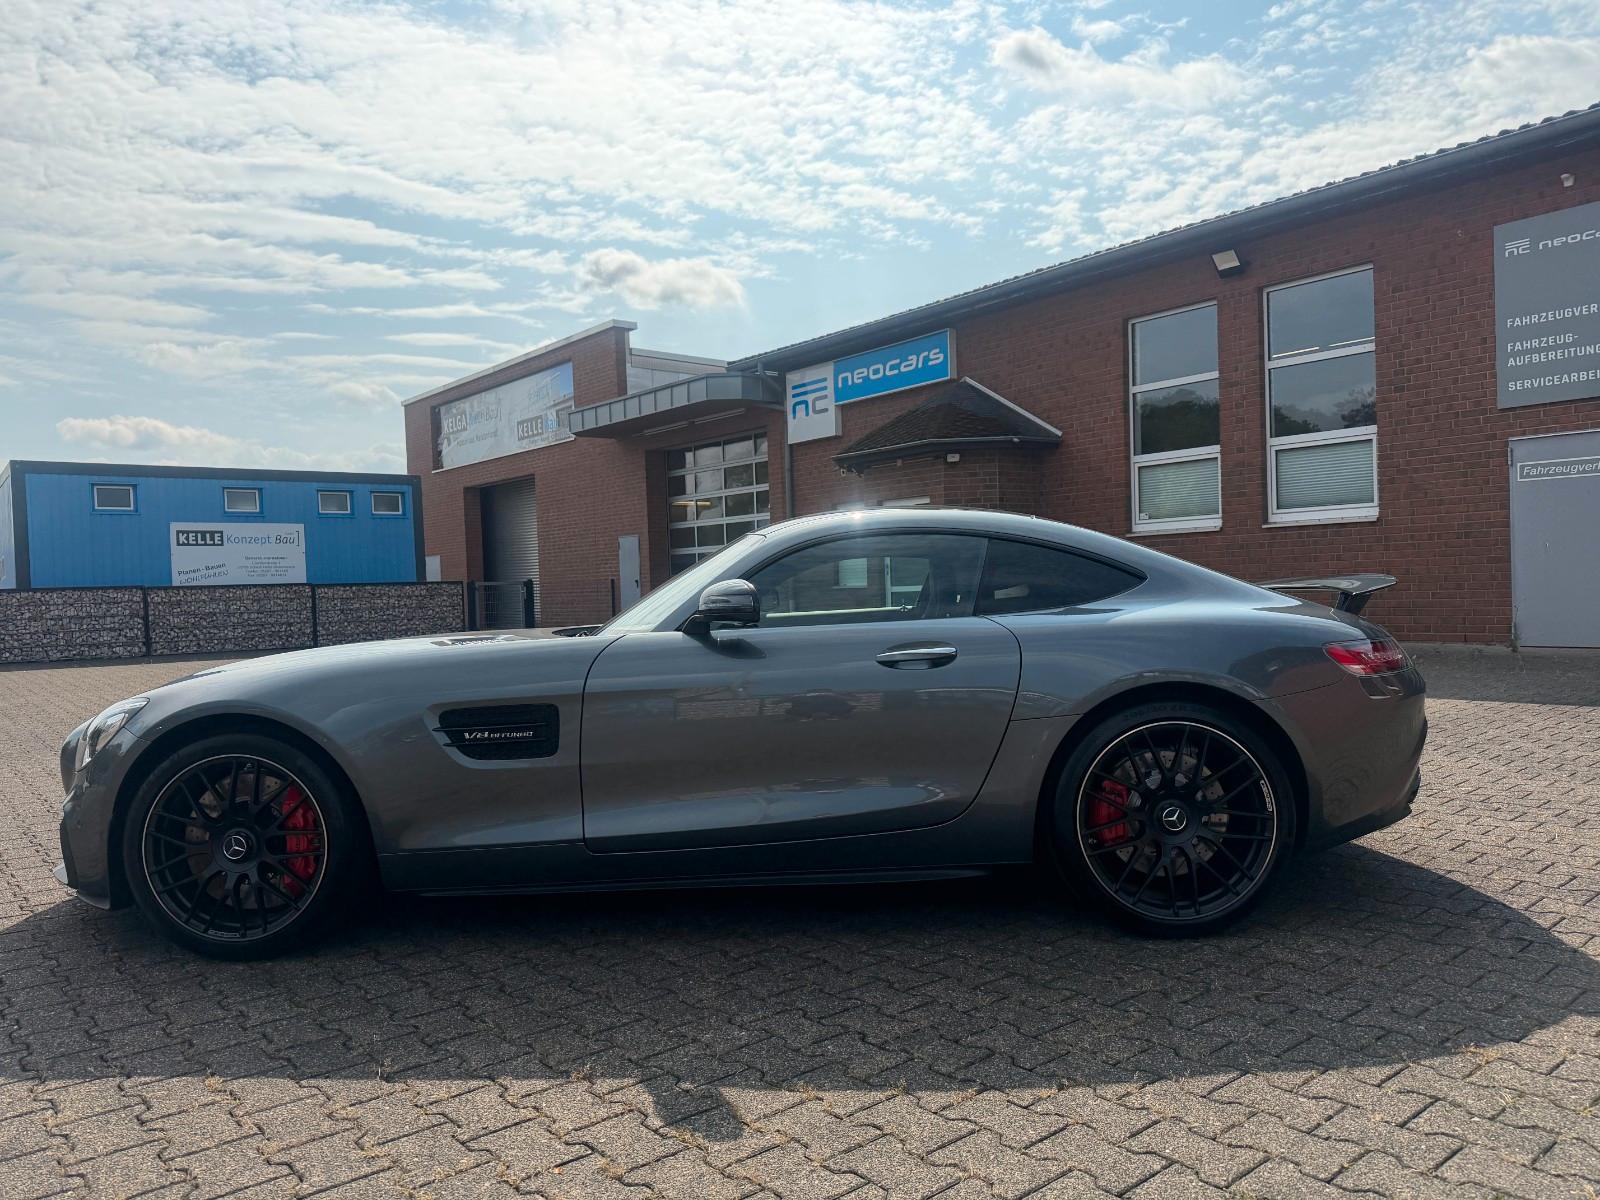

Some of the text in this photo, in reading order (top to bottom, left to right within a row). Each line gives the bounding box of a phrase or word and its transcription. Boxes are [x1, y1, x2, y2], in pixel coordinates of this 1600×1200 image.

[1507, 303, 1599, 328] FAHRZEUGVER
[1507, 333, 1579, 353] FAHRZEUG-
[838, 348, 944, 389] neocars
[518, 418, 543, 440] KELLE
[178, 532, 222, 545] KELLE
[226, 534, 272, 546] Konzept
